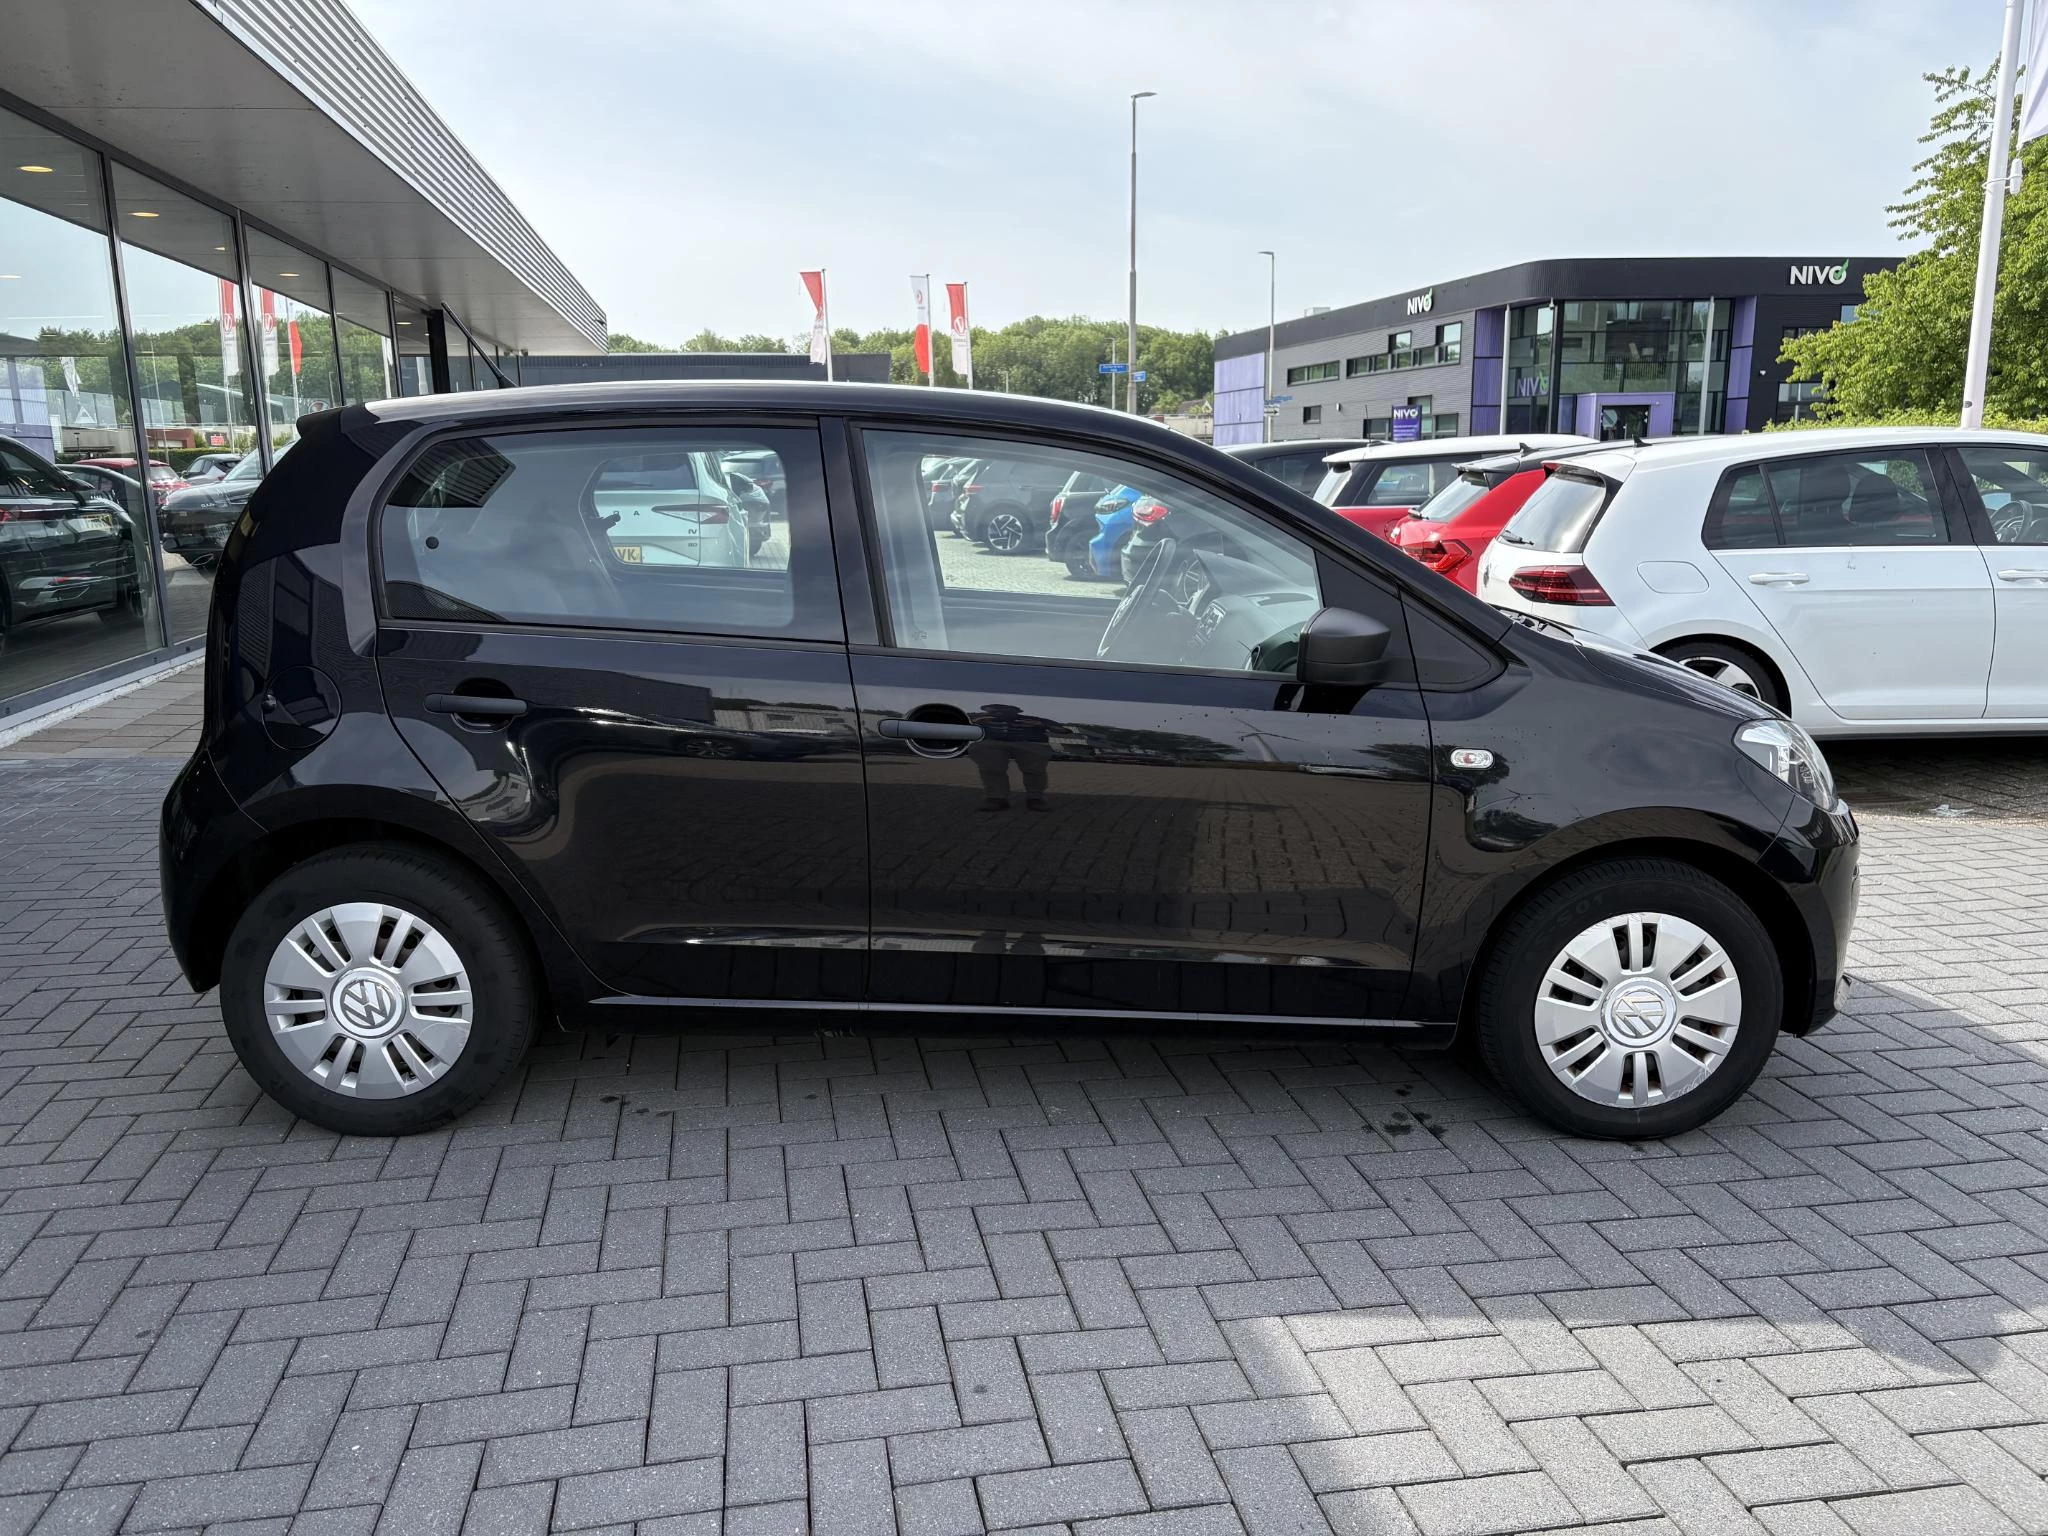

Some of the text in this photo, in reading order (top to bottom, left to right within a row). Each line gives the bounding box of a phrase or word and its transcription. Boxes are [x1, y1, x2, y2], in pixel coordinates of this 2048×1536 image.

[1790, 263, 1847, 285] NIVO
[1407, 292, 1432, 316] NIVO
[1393, 408, 1418, 419] NIVO
